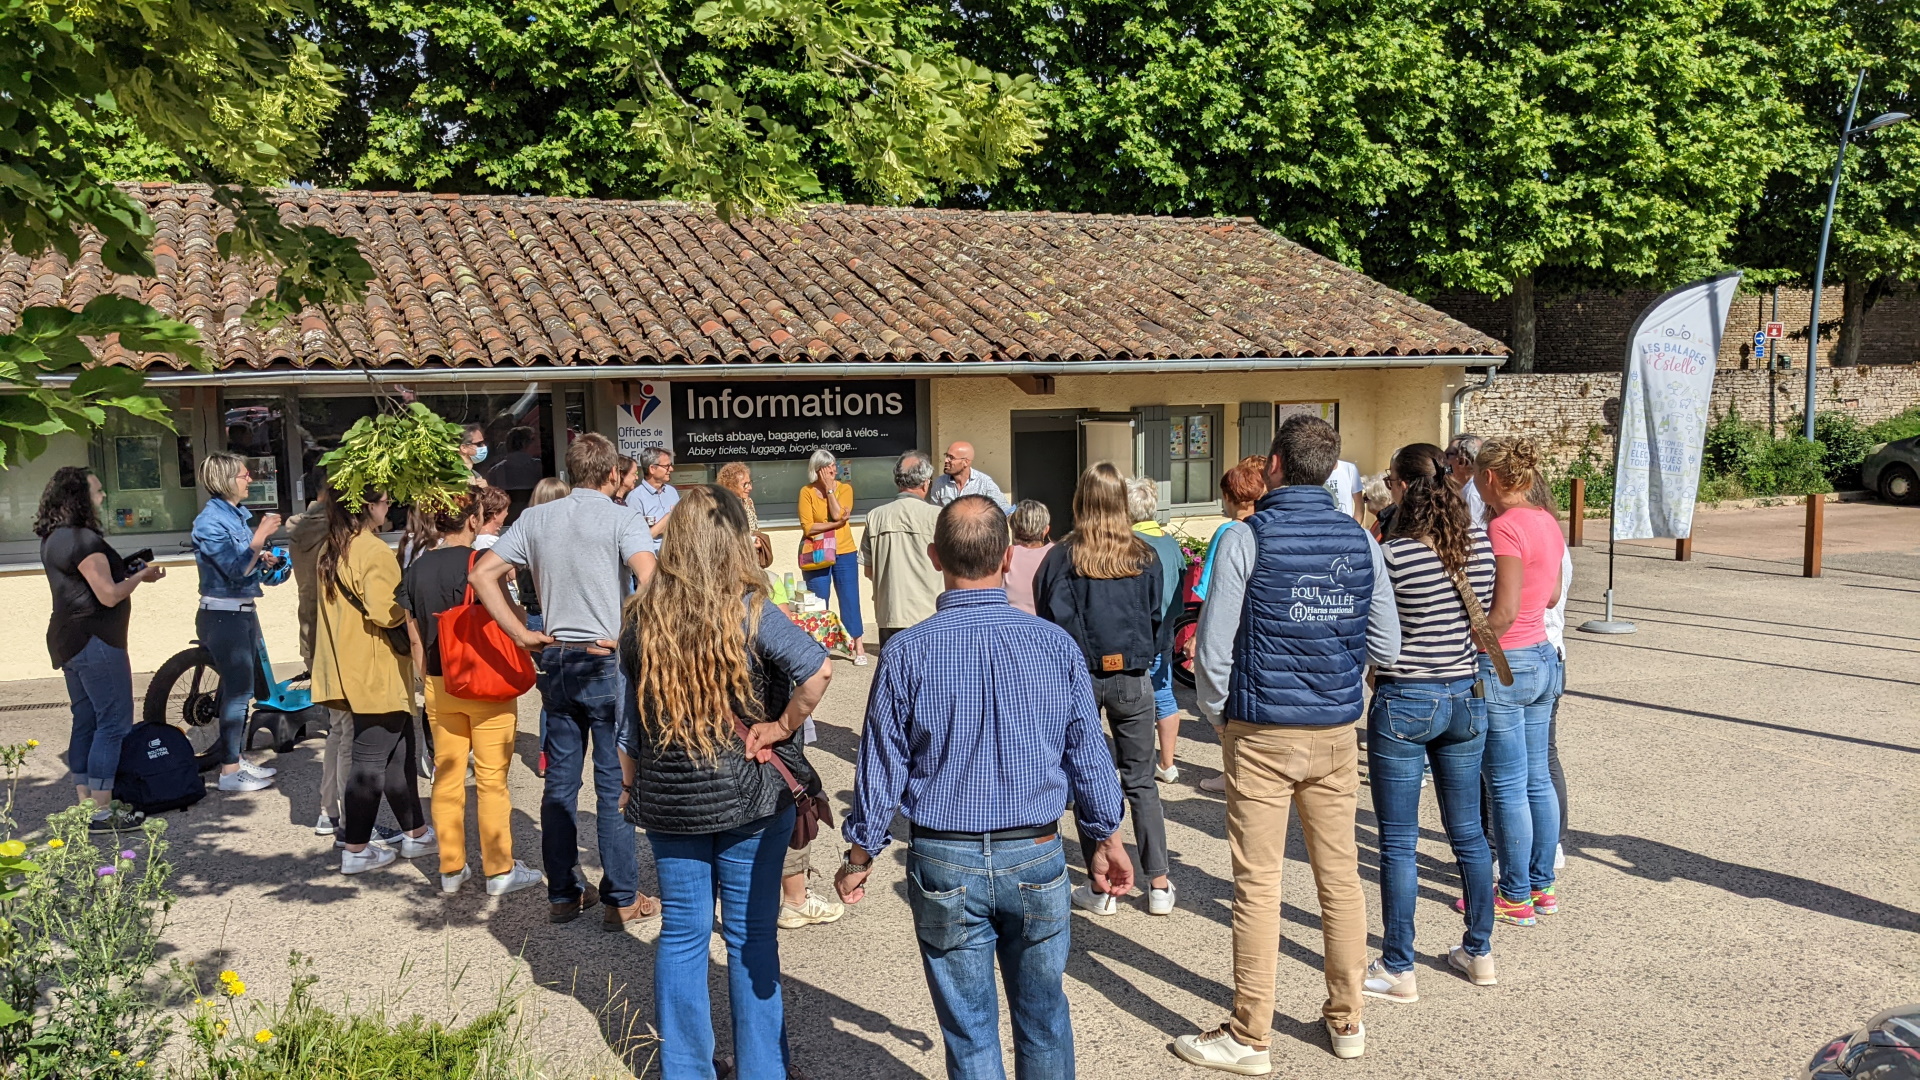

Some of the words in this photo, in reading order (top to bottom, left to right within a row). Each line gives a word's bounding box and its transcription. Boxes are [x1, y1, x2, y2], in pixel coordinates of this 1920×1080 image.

[1642, 343, 1660, 354] LES
[1664, 343, 1707, 366] BALADES
[687, 386, 903, 419] Informations
[618, 426, 652, 437] Offices
[654, 428, 663, 436] de
[687, 432, 724, 443] Tickets
[726, 431, 766, 443] abbaye,
[768, 429, 819, 442] bagagerie,
[821, 428, 844, 438] local
[846, 428, 852, 438] à
[854, 427, 879, 437] vélos
[619, 438, 664, 449] Tourisme
[687, 446, 717, 458] Abbey
[718, 445, 748, 455] tickets,
[750, 444, 787, 456] luggage,
[789, 443, 819, 454] bicycle
[820, 442, 857, 452] storage...
[1291, 586, 1319, 599] ÉQUI
[1318, 592, 1355, 606] VALLÉE
[1307, 606, 1328, 614] Haras
[1329, 605, 1354, 614] national
[1307, 613, 1315, 621] de
